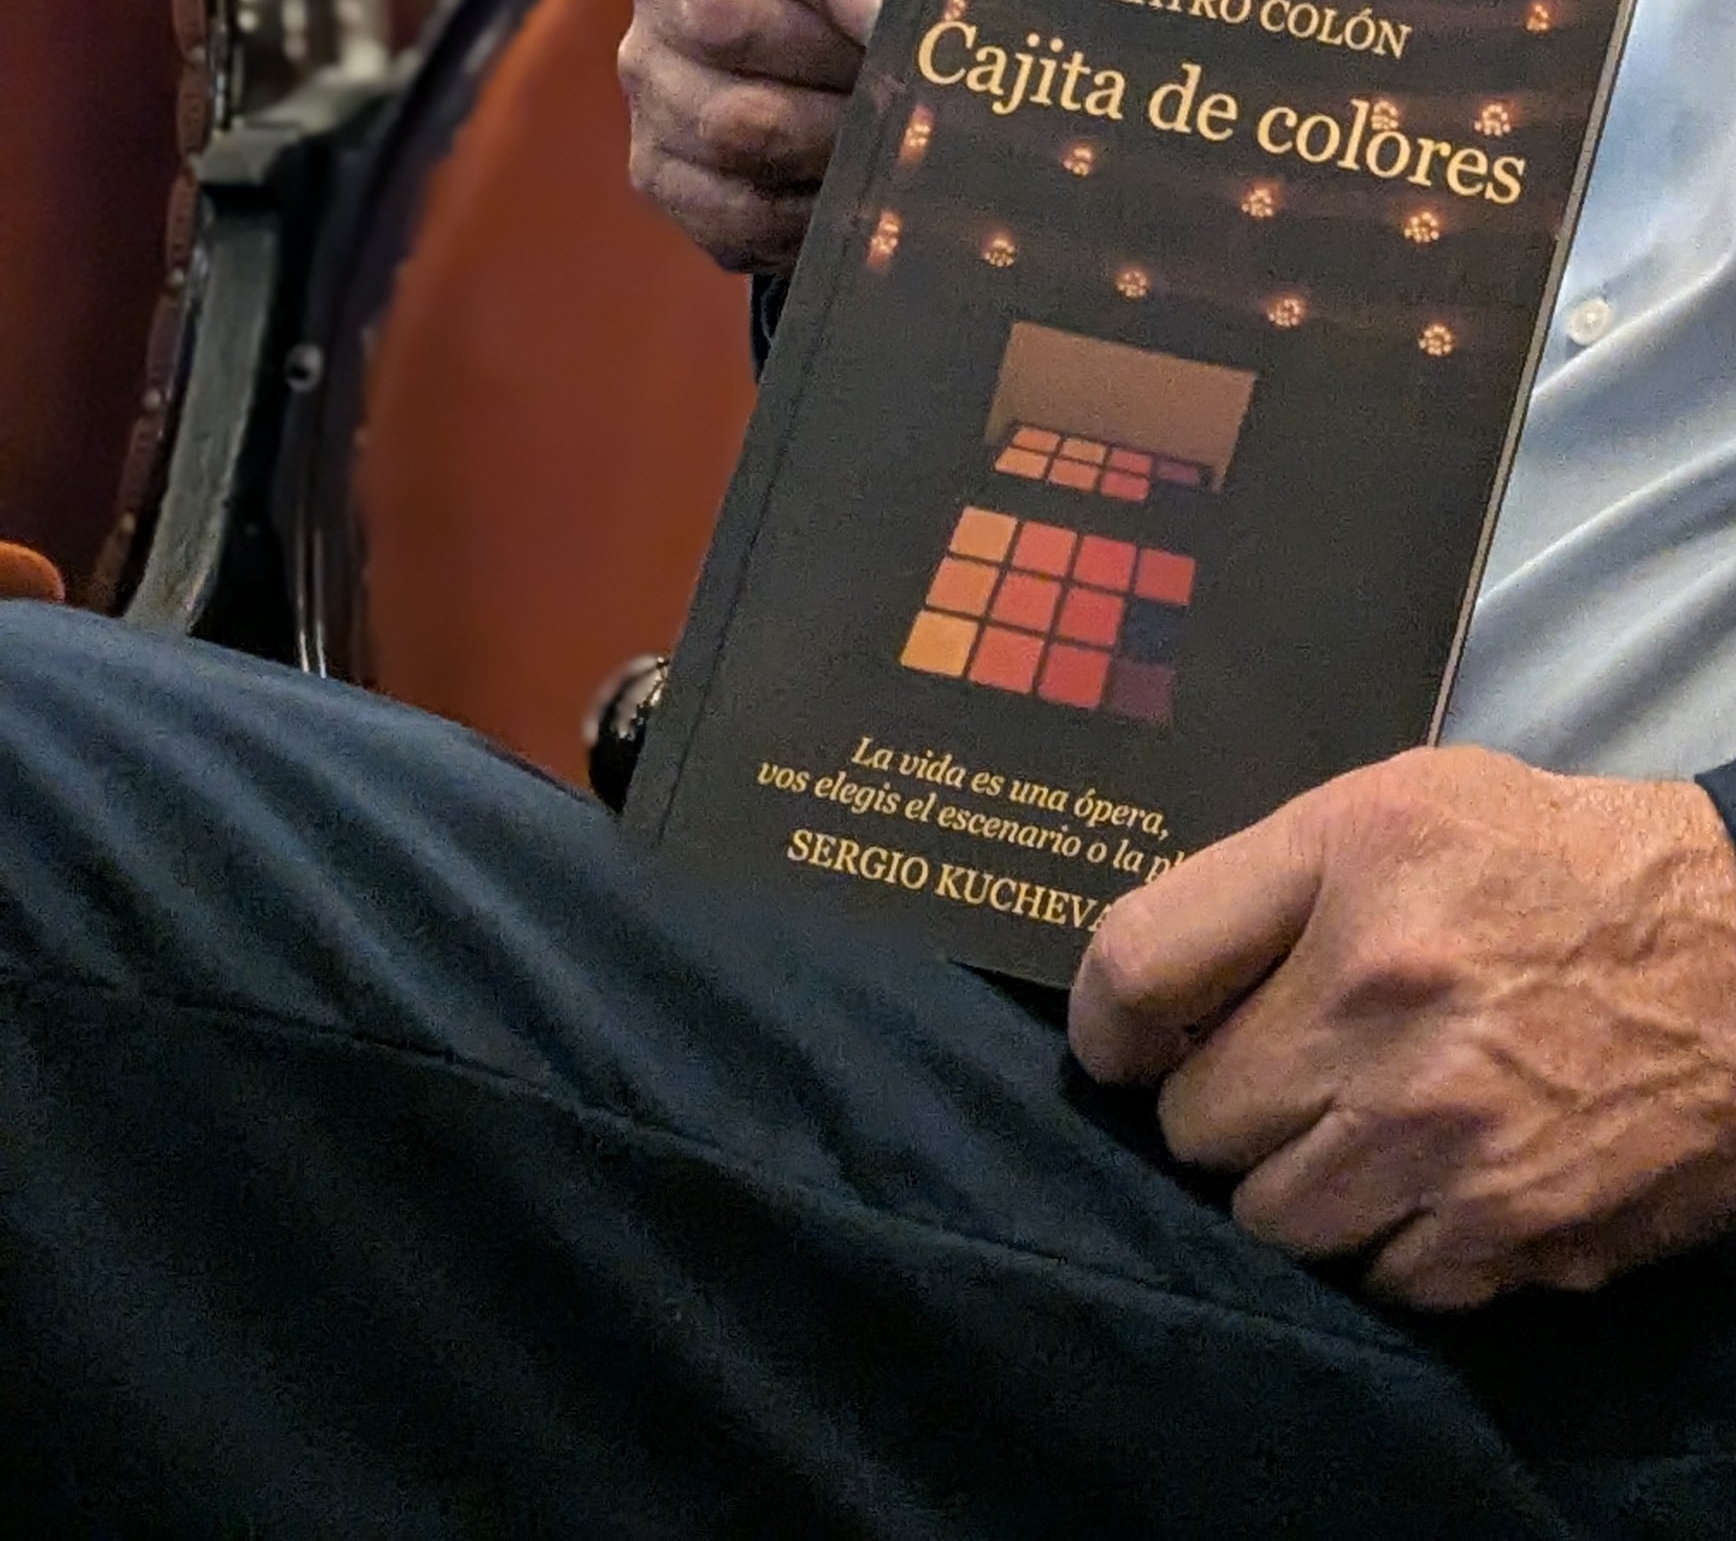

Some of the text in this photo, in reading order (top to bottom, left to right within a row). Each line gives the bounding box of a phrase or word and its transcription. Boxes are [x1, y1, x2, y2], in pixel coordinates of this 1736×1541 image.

[917, 21, 1526, 204] Cajita de colores
[758, 762, 809, 793] vos
[814, 773, 900, 816] elegis
[905, 794, 935, 823] el
[937, 808, 1082, 857] escenario
[1086, 839, 1108, 863] o
[1113, 846, 1144, 873] la
[851, 736, 1169, 839] La vida es una ópera,
[787, 829, 929, 889] SERGIO
